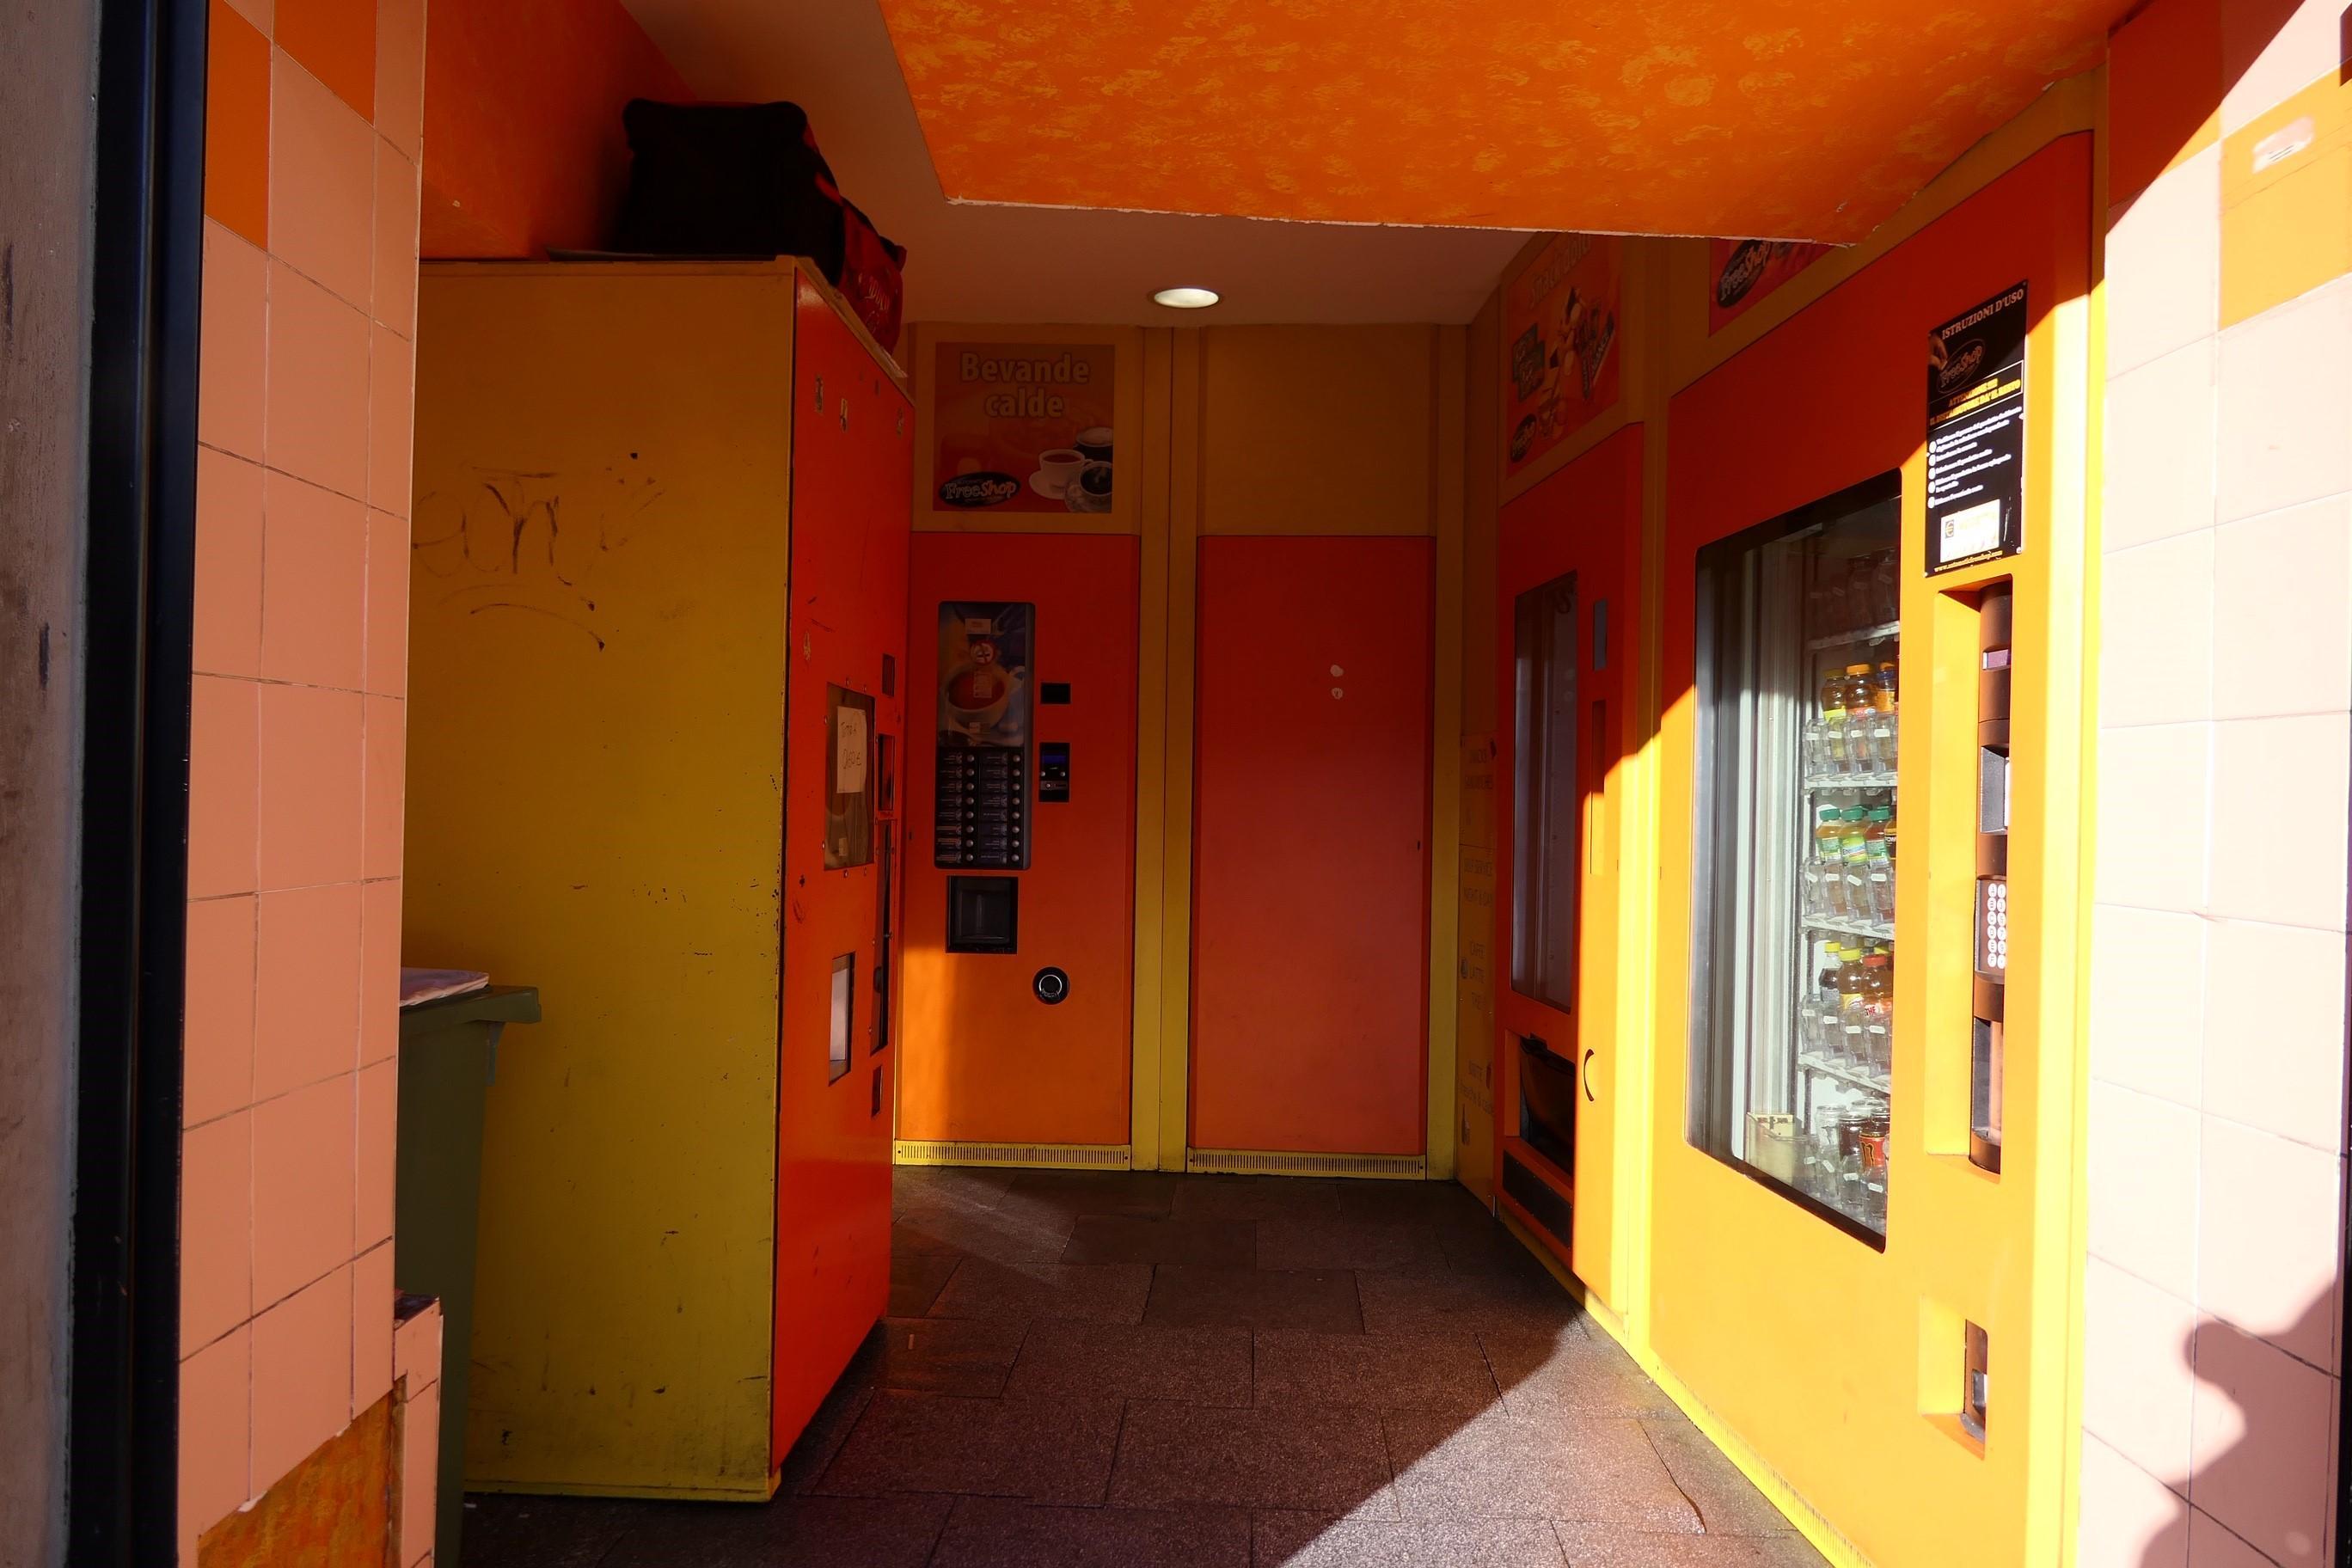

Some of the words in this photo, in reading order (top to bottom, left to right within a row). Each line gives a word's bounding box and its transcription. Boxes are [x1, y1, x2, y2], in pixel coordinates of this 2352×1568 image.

[1942, 304, 1994, 340] ISTRUZIONI
[1994, 288, 2024, 312] D'USO
[960, 351, 1091, 384] Bevande
[985, 387, 1065, 419] calde
[945, 479, 1018, 499] FreeShop
